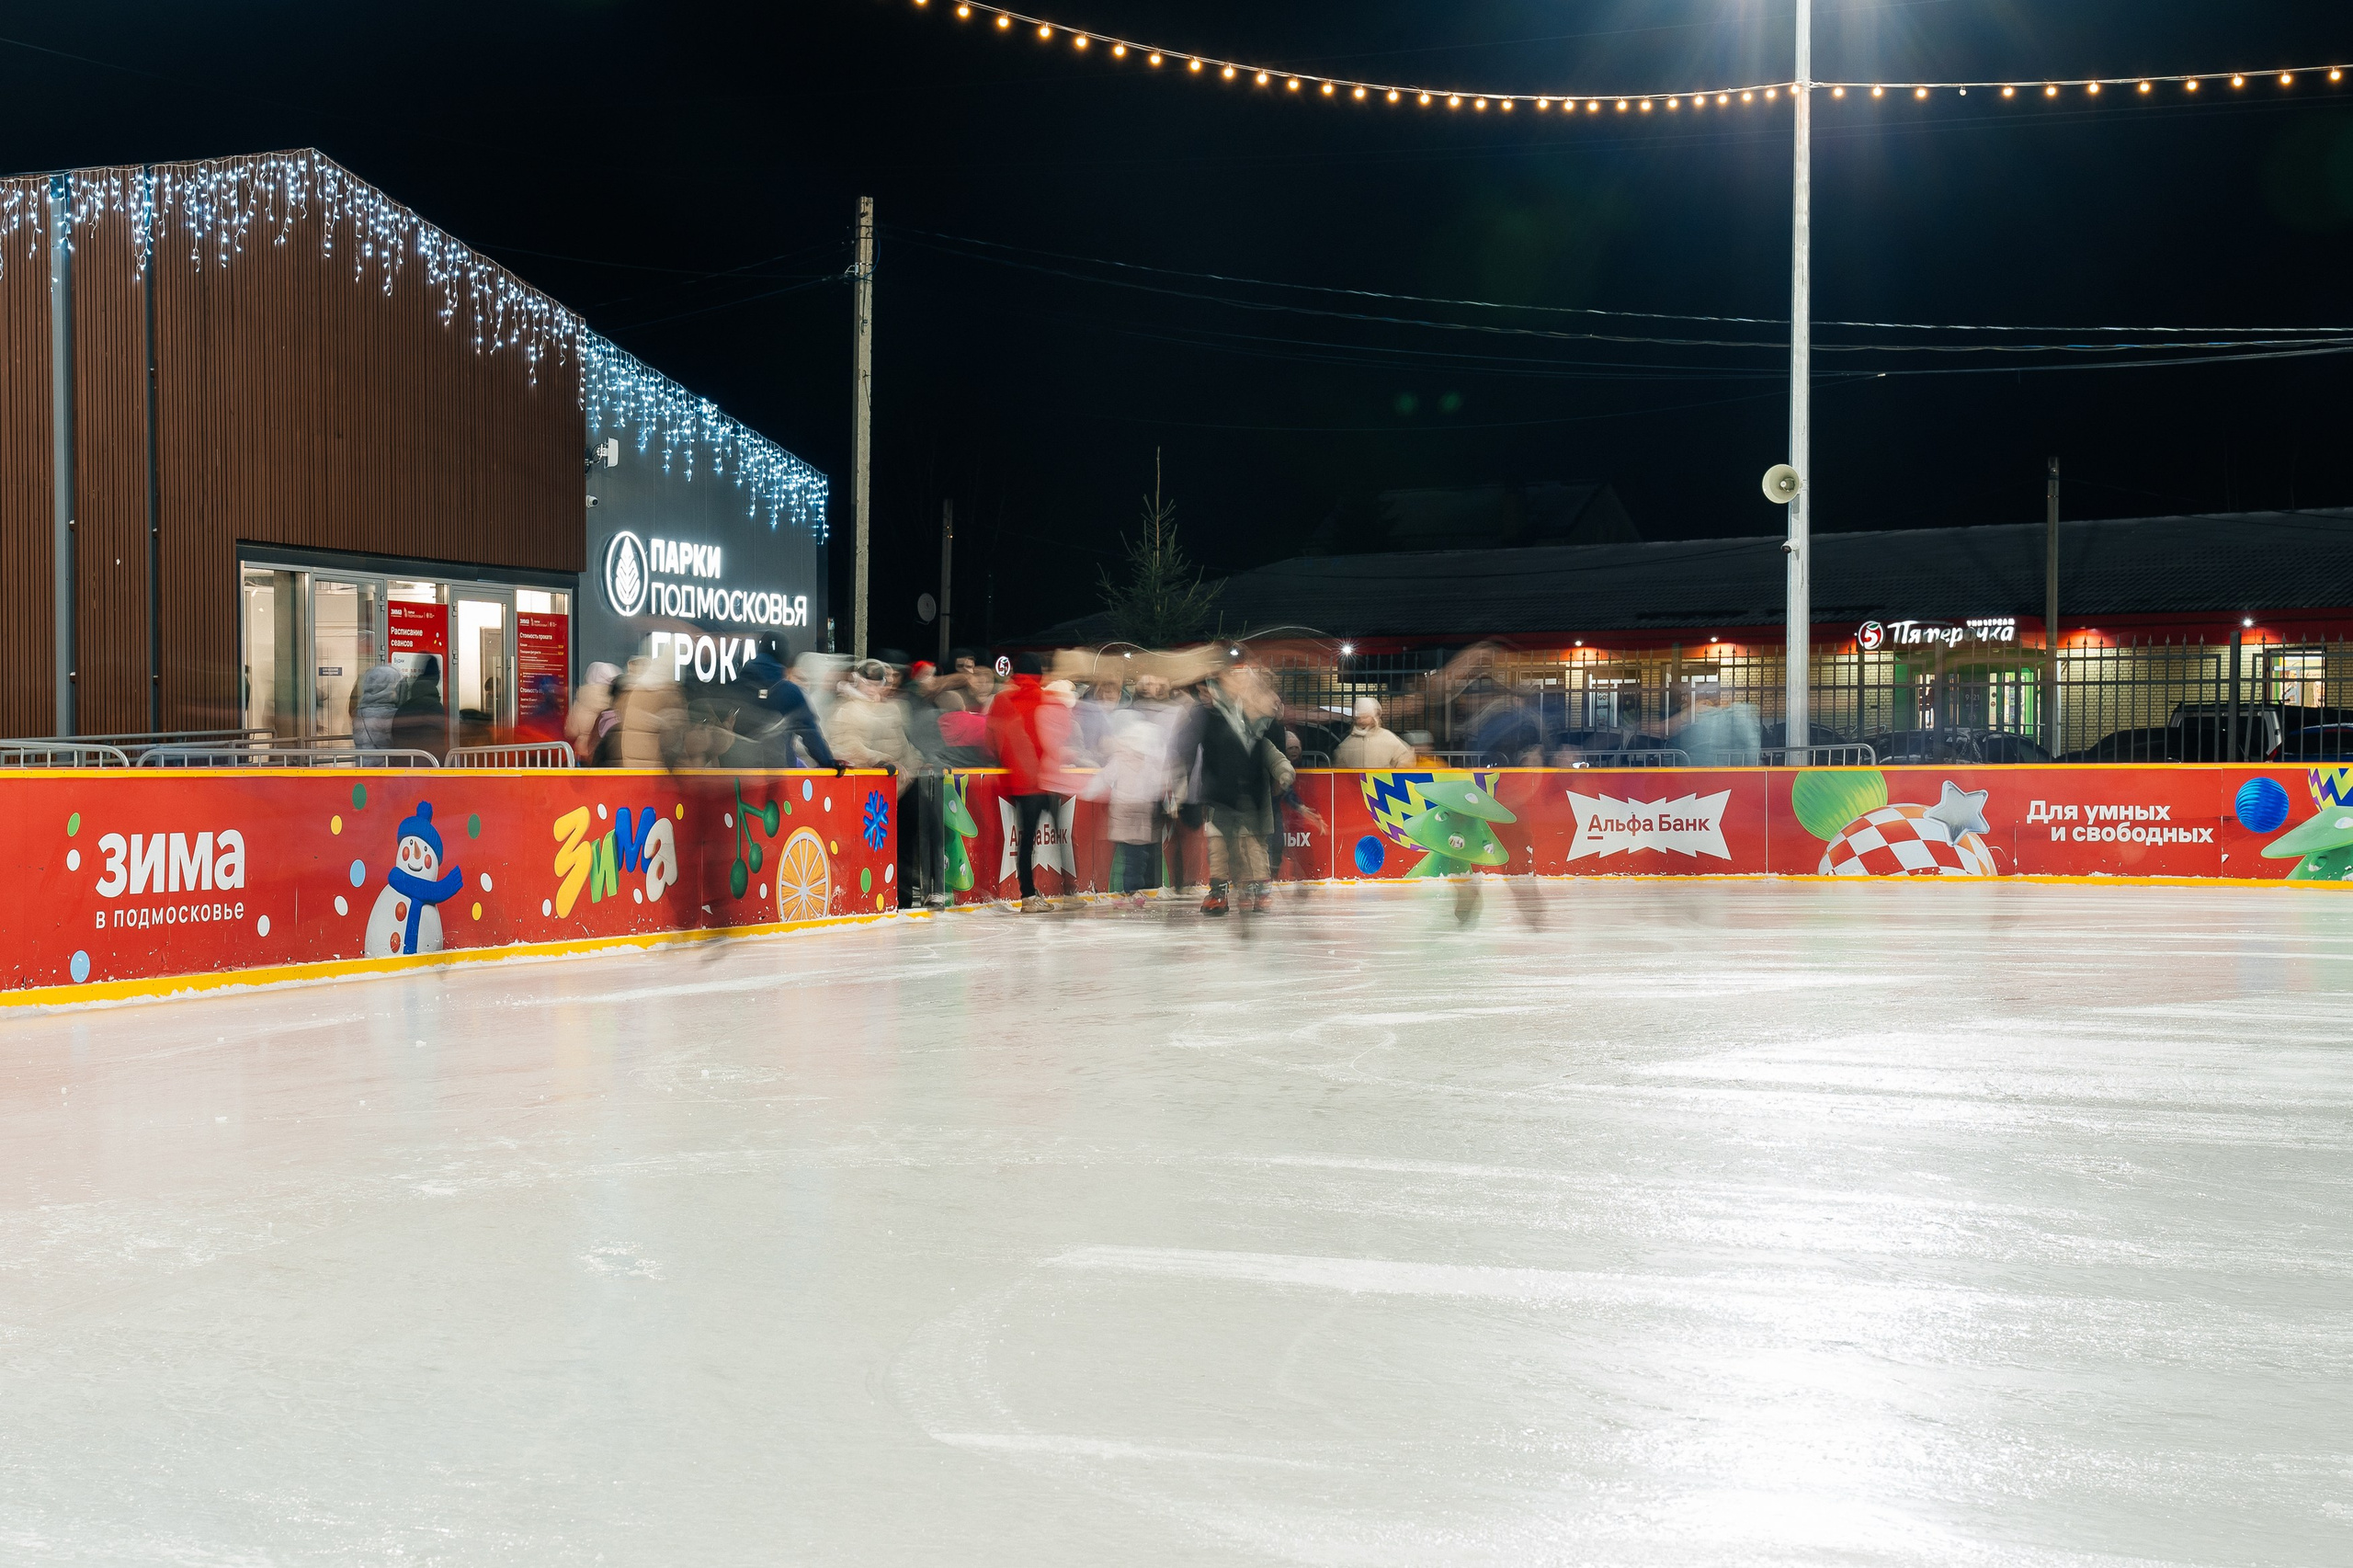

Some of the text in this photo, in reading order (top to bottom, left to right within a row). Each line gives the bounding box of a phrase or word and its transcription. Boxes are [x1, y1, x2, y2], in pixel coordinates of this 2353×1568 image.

[651, 538, 722, 579] ПАРКИ
[651, 582, 807, 627] ПОДМОСКОВЬЯ
[391, 626, 423, 637] Расписание
[1887, 620, 2016, 648] Пятерочка
[651, 631, 777, 686] ПРОКА
[1587, 813, 1711, 837] Альфа Банк
[2027, 801, 2172, 825] Для умных
[1043, 824, 1068, 846] Банк
[2051, 822, 2214, 846] и свободных
[96, 902, 245, 930] в подмосковье
